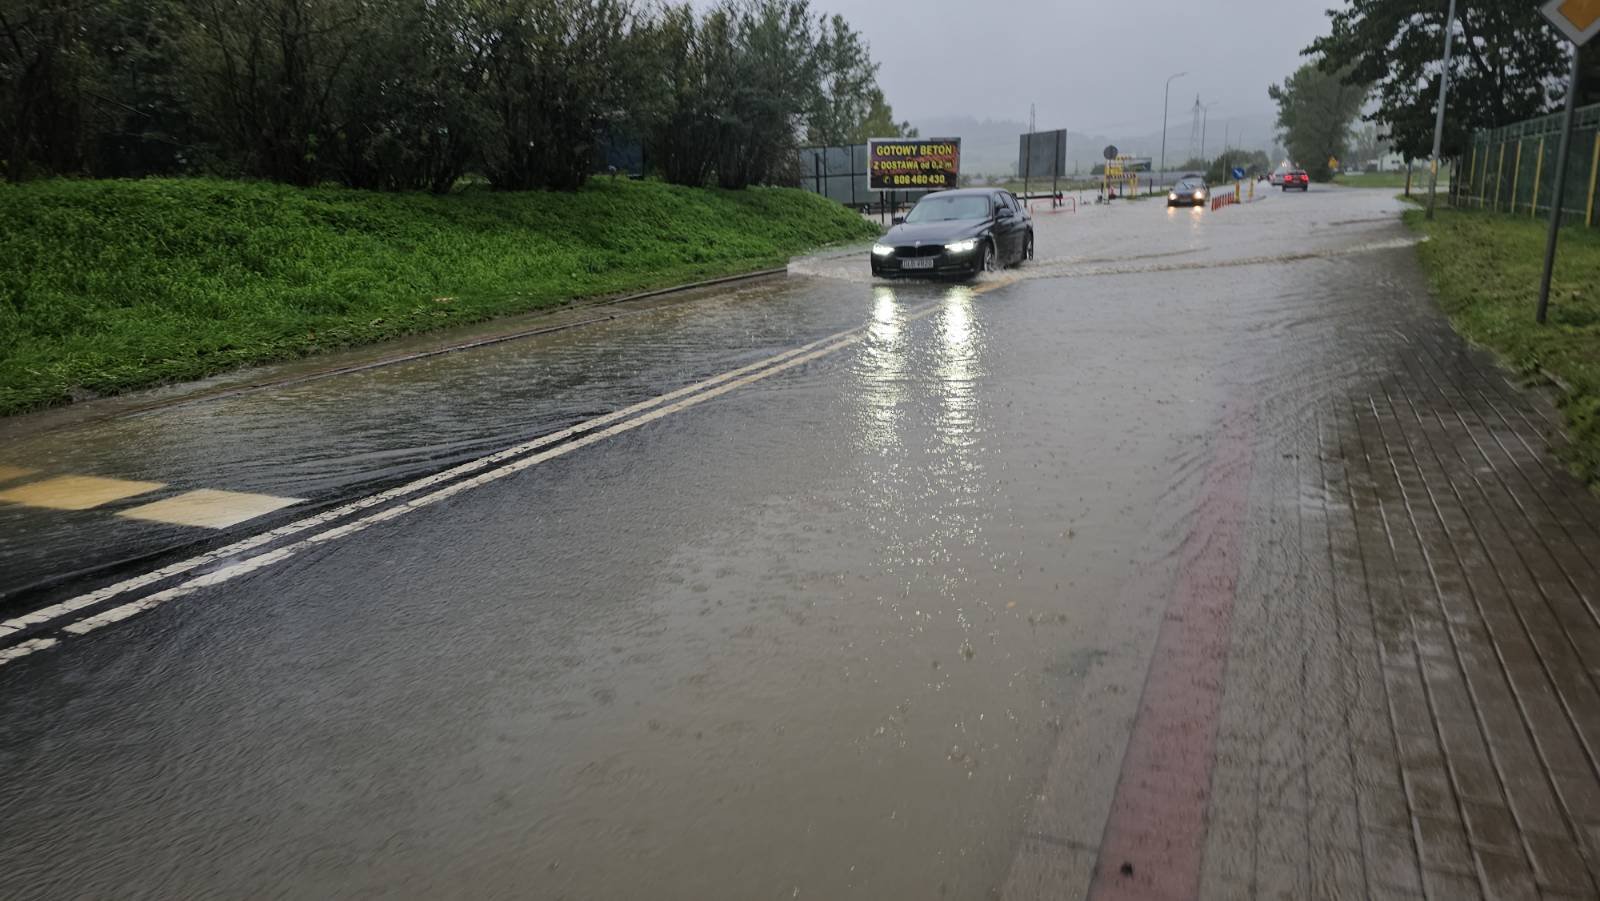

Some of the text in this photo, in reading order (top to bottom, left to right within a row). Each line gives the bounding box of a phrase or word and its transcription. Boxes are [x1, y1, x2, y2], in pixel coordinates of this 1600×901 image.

[877, 144, 952, 156] GOTOWY BETON
[920, 160, 929, 169] od
[929, 174, 945, 184] 430
